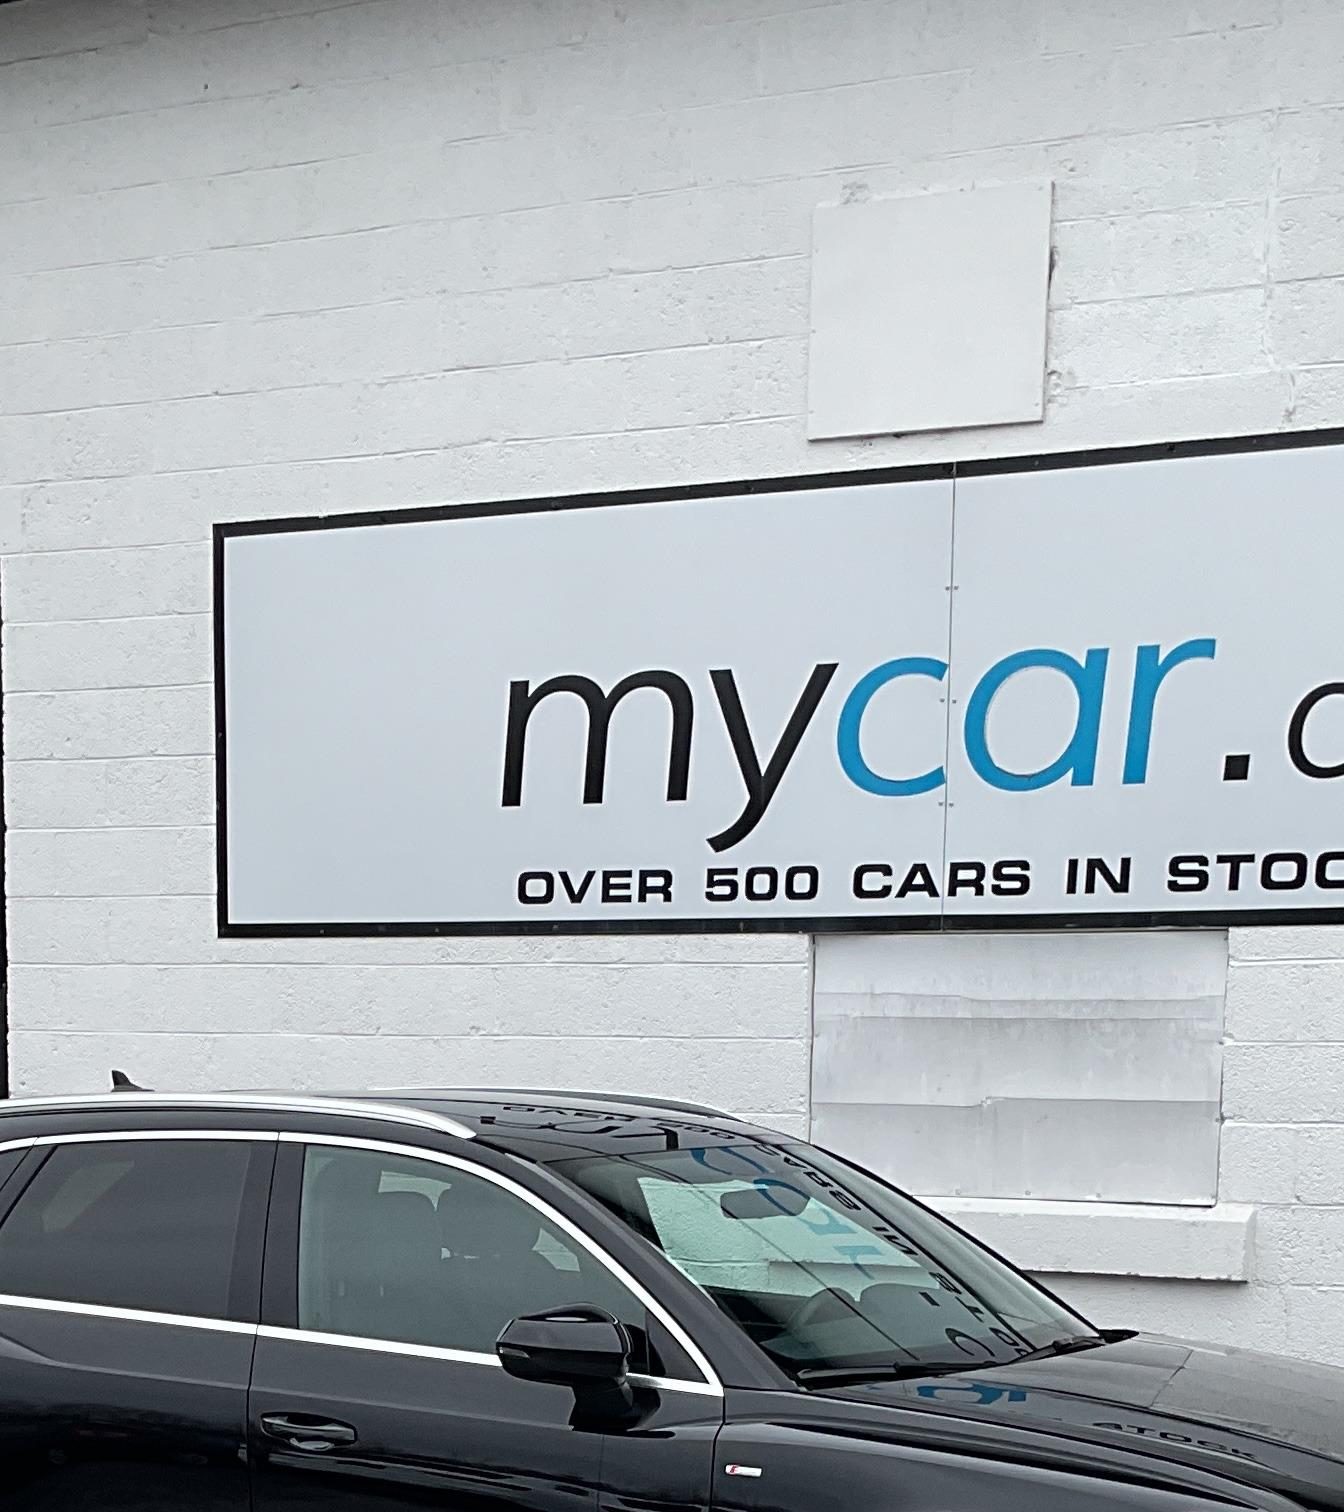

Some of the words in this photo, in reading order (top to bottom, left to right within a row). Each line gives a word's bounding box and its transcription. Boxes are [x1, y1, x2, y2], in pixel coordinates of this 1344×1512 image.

[517, 869, 673, 905] OVER
[704, 865, 819, 902] 500
[852, 859, 1031, 899] CARS
[1066, 857, 1132, 895] IN
